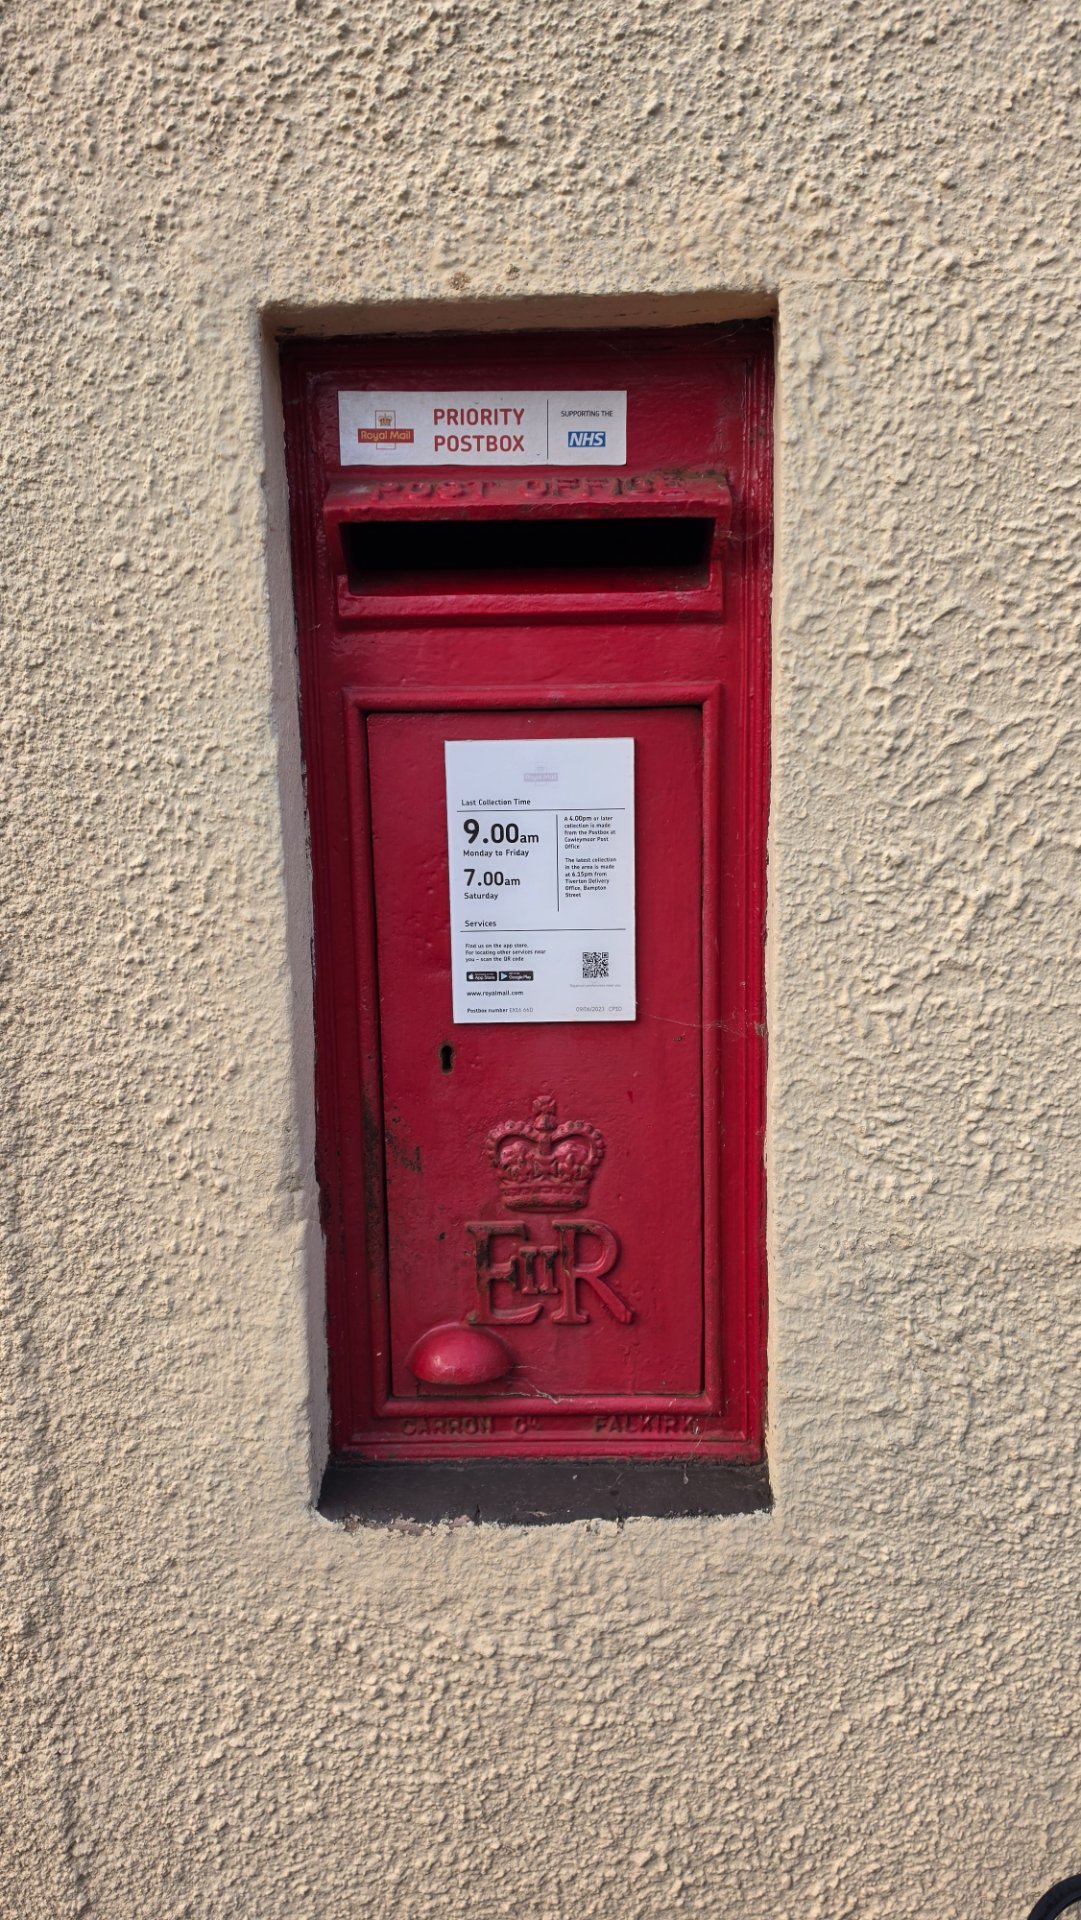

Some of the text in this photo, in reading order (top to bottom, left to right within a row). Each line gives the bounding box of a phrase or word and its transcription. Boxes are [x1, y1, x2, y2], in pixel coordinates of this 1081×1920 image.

[433, 408, 525, 426] PRIORITY
[361, 430, 411, 442] Royal Mail
[434, 435, 525, 452] POSTBOX
[568, 432, 604, 446] NHS
[373, 475, 688, 500] POST OFFICE
[463, 819, 539, 844] 9.00am
[506, 849, 529, 857] Friday
[464, 869, 520, 886] 7.00am
[401, 1416, 494, 1436] CARRON
[593, 1415, 699, 1434] FALKIRK
